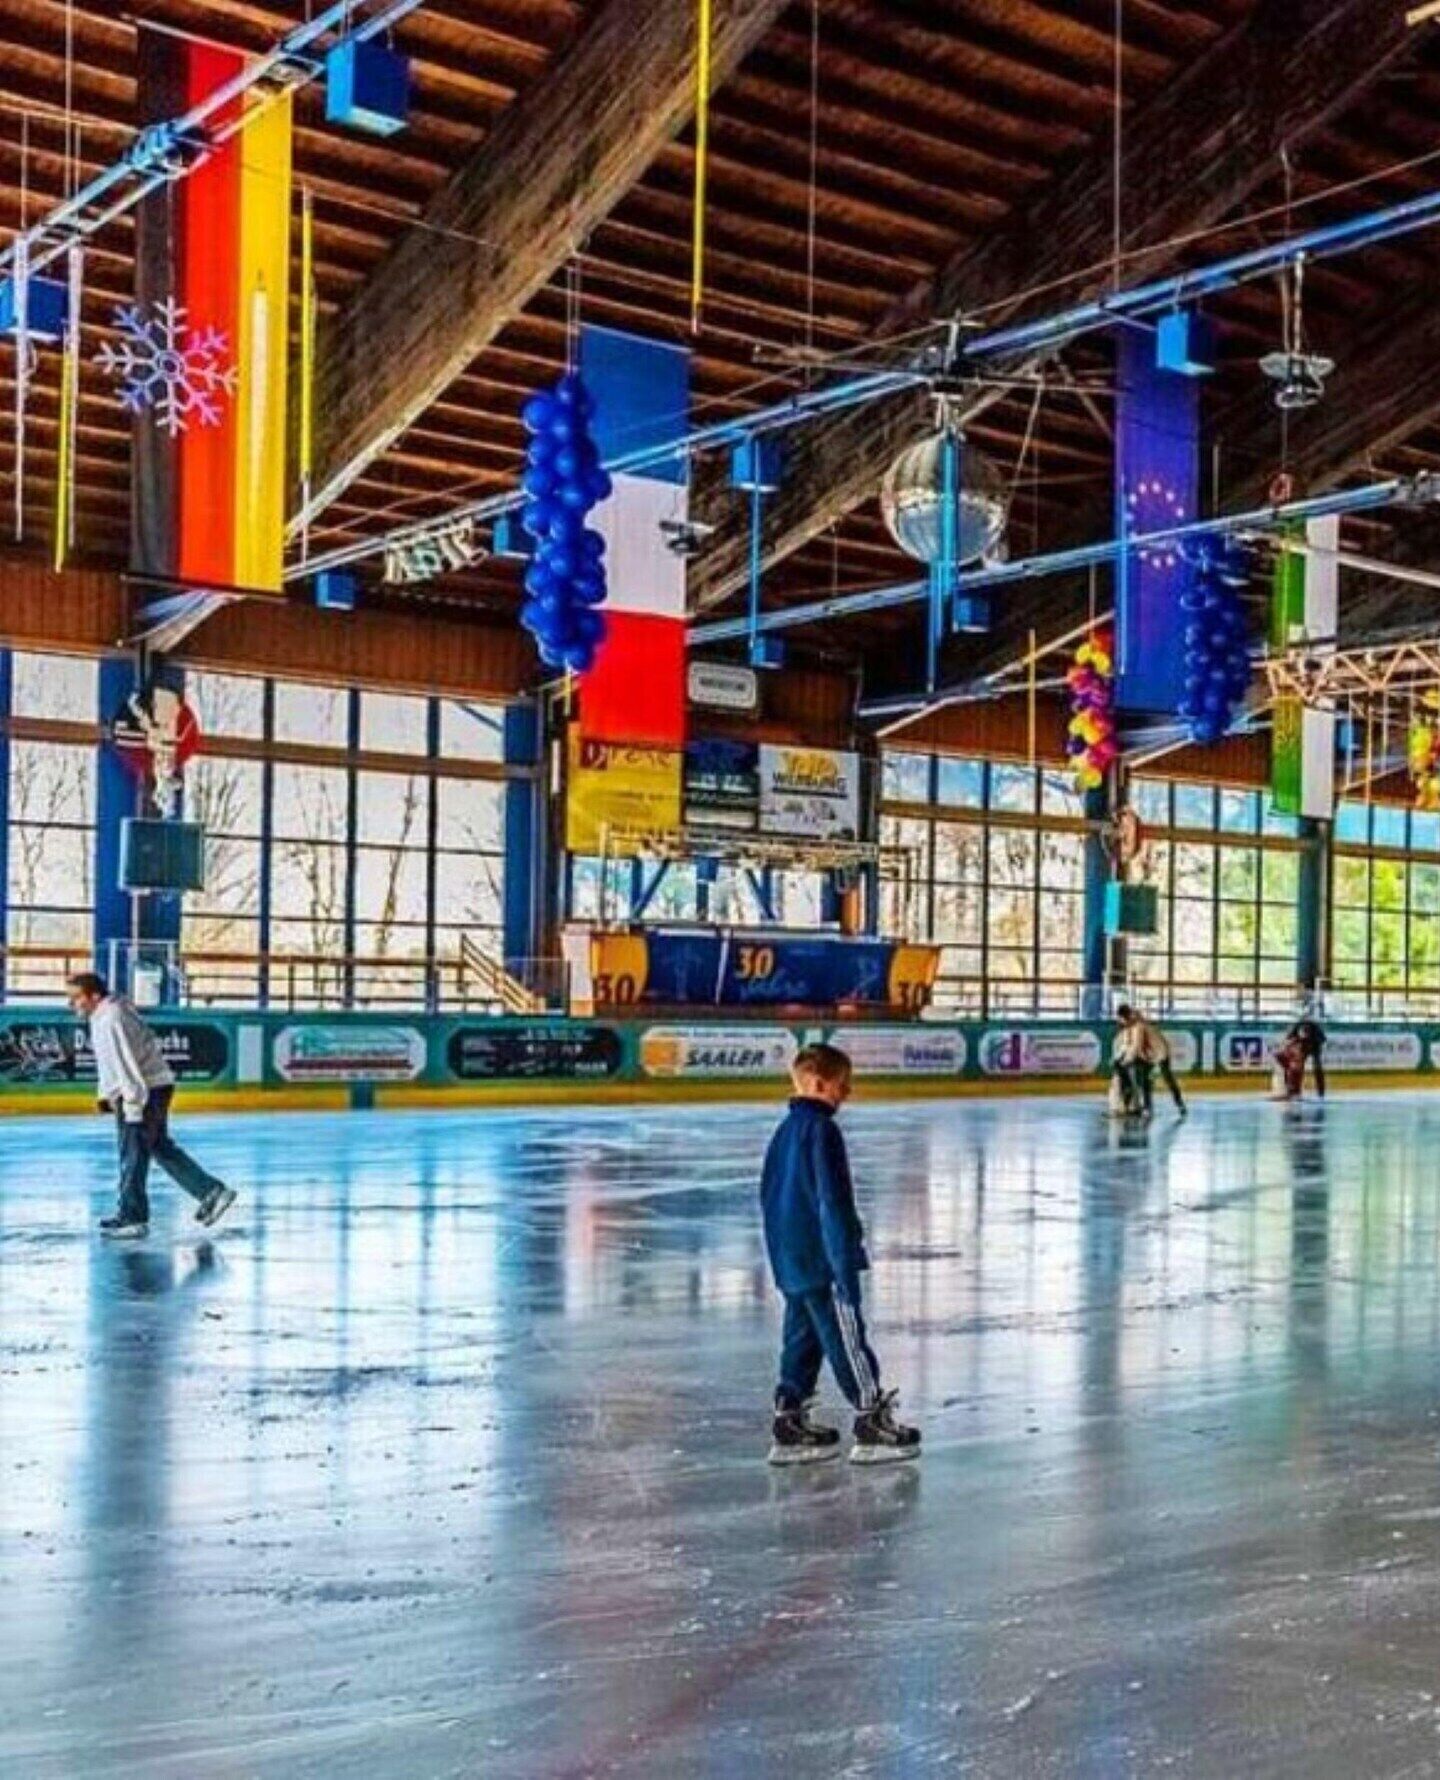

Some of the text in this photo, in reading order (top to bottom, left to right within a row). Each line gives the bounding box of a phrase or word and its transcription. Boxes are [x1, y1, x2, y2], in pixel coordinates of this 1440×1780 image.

[735, 947, 775, 979] 30
[594, 975, 637, 1005] 30
[898, 981, 931, 1009] 30
[685, 1048, 766, 1067] SAALER
